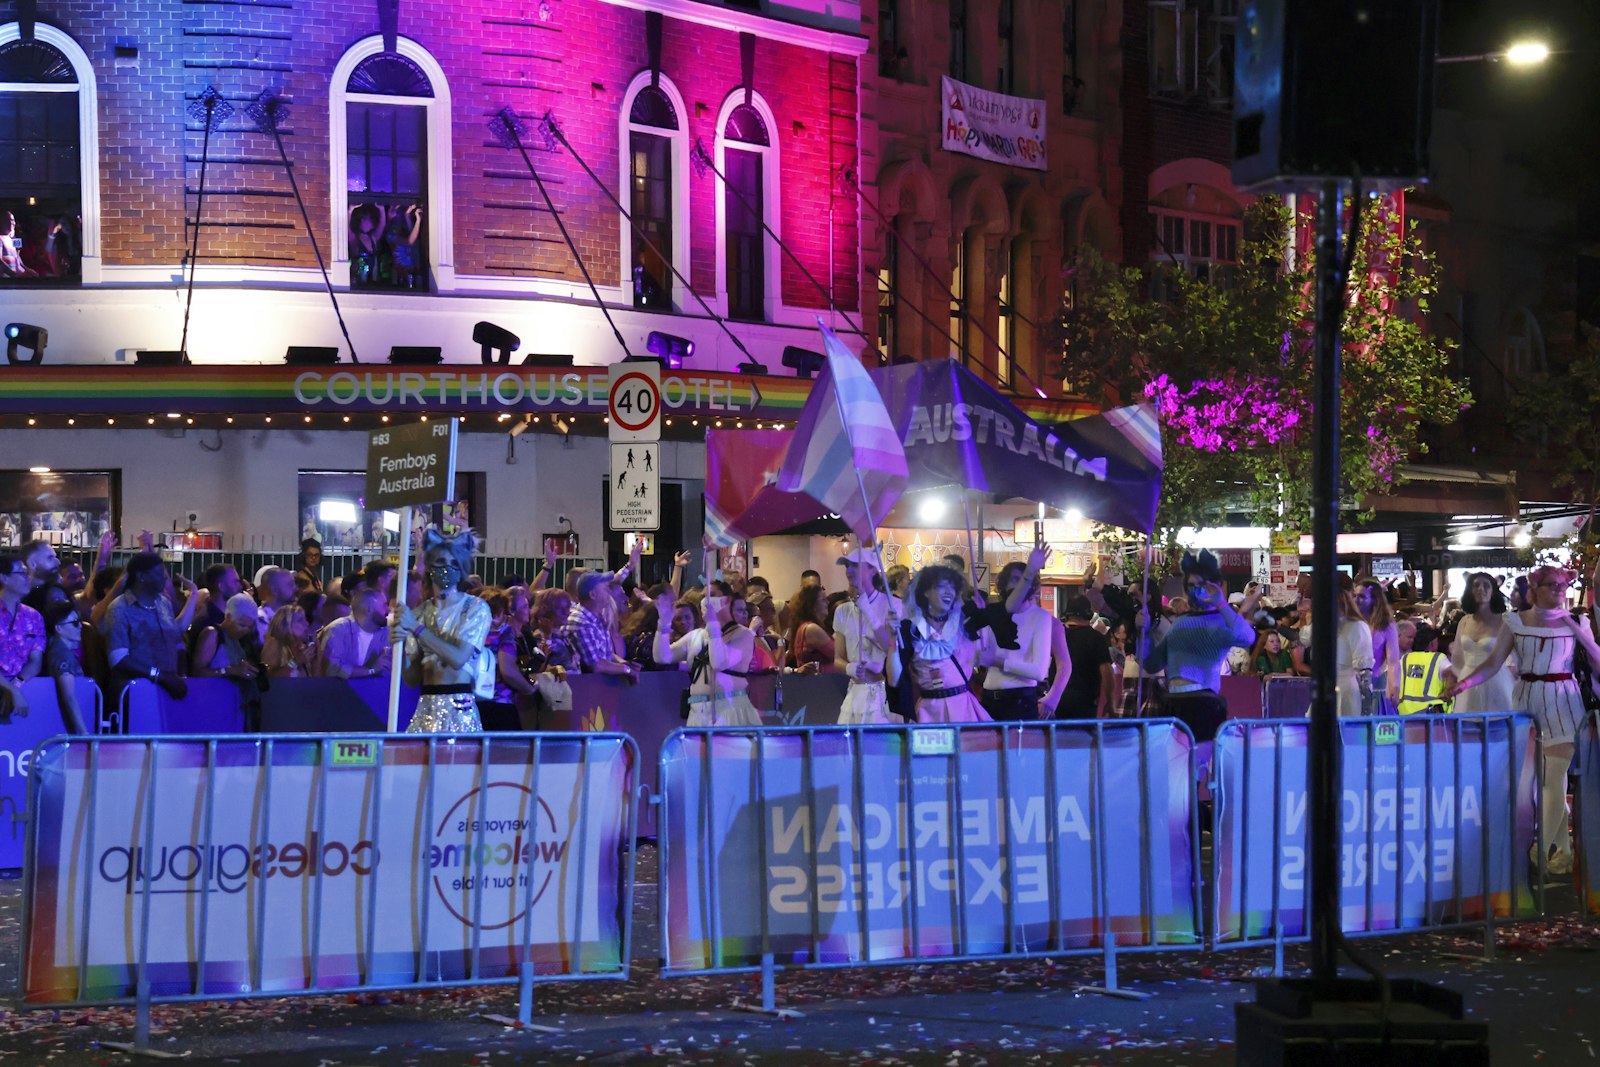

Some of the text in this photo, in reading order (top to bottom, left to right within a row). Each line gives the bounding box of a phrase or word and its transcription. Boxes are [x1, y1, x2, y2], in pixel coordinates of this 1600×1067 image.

[294, 371, 740, 411] COURTHOUSE OTEL
[617, 388, 652, 414] 40
[372, 433, 390, 446] #83
[904, 402, 1107, 481] AUSTRALIA
[380, 453, 437, 473] Femboys
[378, 472, 435, 494] Australia
[887, 544, 895, 562] 5
[723, 555, 743, 572] $15
[338, 743, 370, 757] TFH
